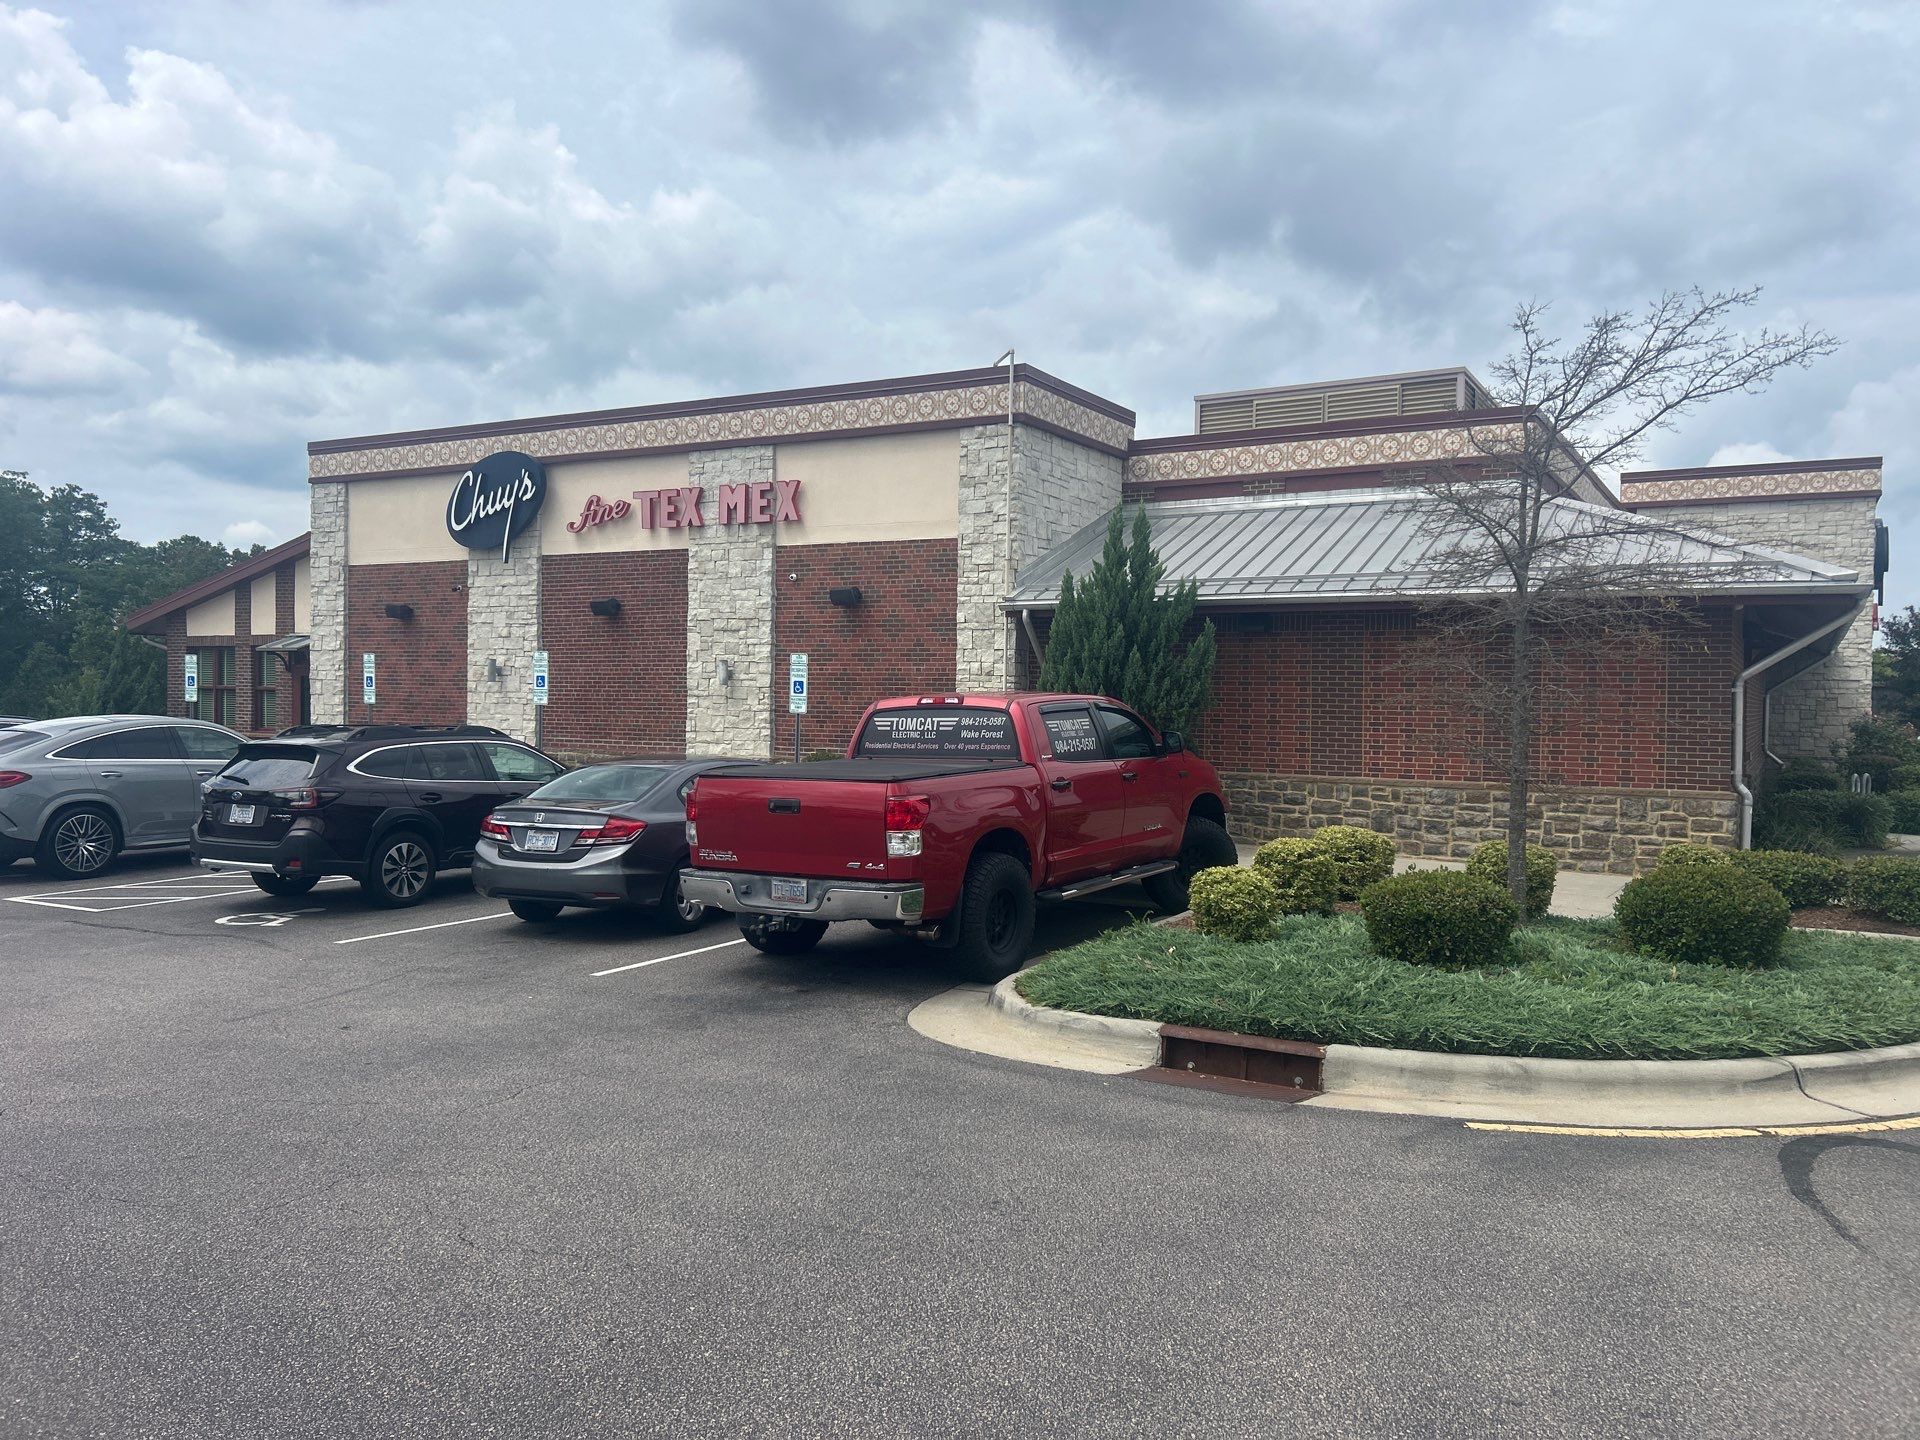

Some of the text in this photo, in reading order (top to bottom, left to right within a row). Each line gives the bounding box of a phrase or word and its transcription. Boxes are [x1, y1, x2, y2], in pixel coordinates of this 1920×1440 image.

[567, 480, 802, 534] fine TEX MEX
[451, 468, 536, 562] Chuy's
[889, 717, 941, 730] TOMCAT
[960, 717, 1006, 726] 984-215-0587
[1055, 719, 1084, 731] TOMCAT
[960, 730, 1003, 738] Wake Forest
[864, 741, 892, 749] Residential
[1054, 737, 1096, 753] 984-215-0587
[699, 853, 738, 861] TUNDRA
[773, 883, 805, 897] TFL-7654
